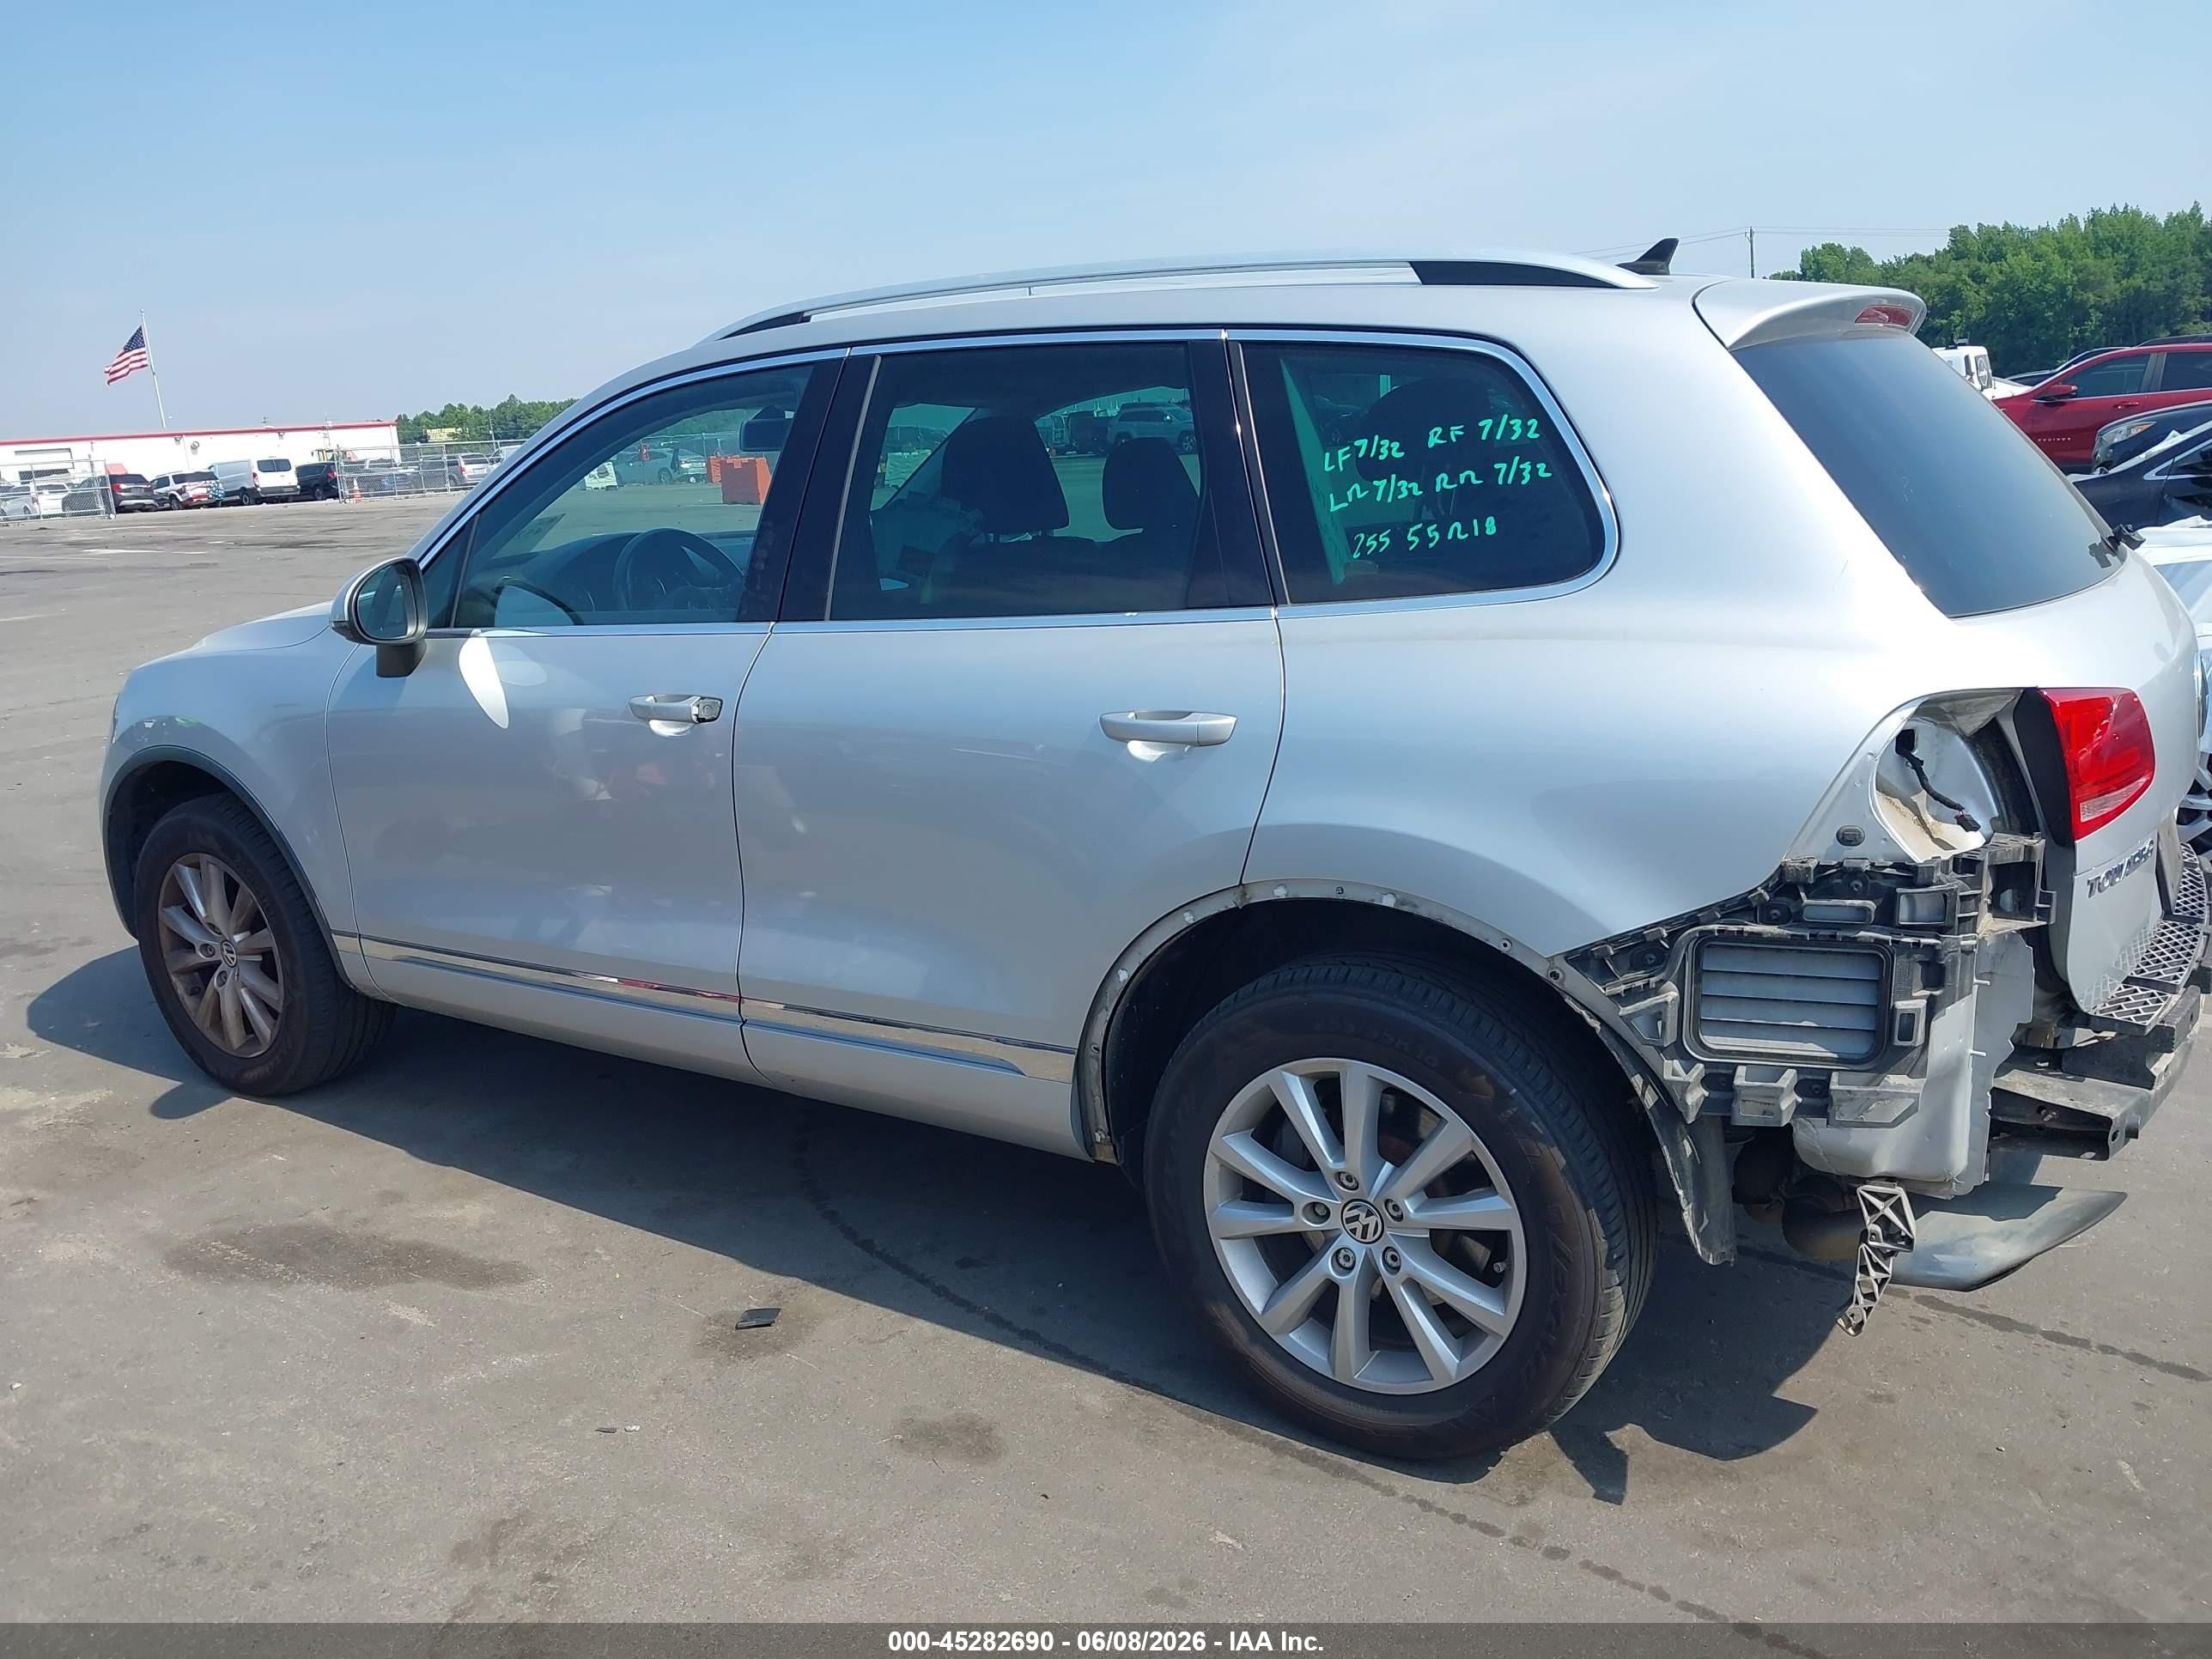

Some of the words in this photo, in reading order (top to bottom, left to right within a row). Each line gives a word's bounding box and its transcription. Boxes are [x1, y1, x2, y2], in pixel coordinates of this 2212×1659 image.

[1428, 425, 1464, 447] RF
[1478, 414, 1540, 440] 7/32
[1372, 474, 1424, 502] 7/32
[1493, 456, 1553, 484] 7/32
[1352, 529, 1391, 558] 255
